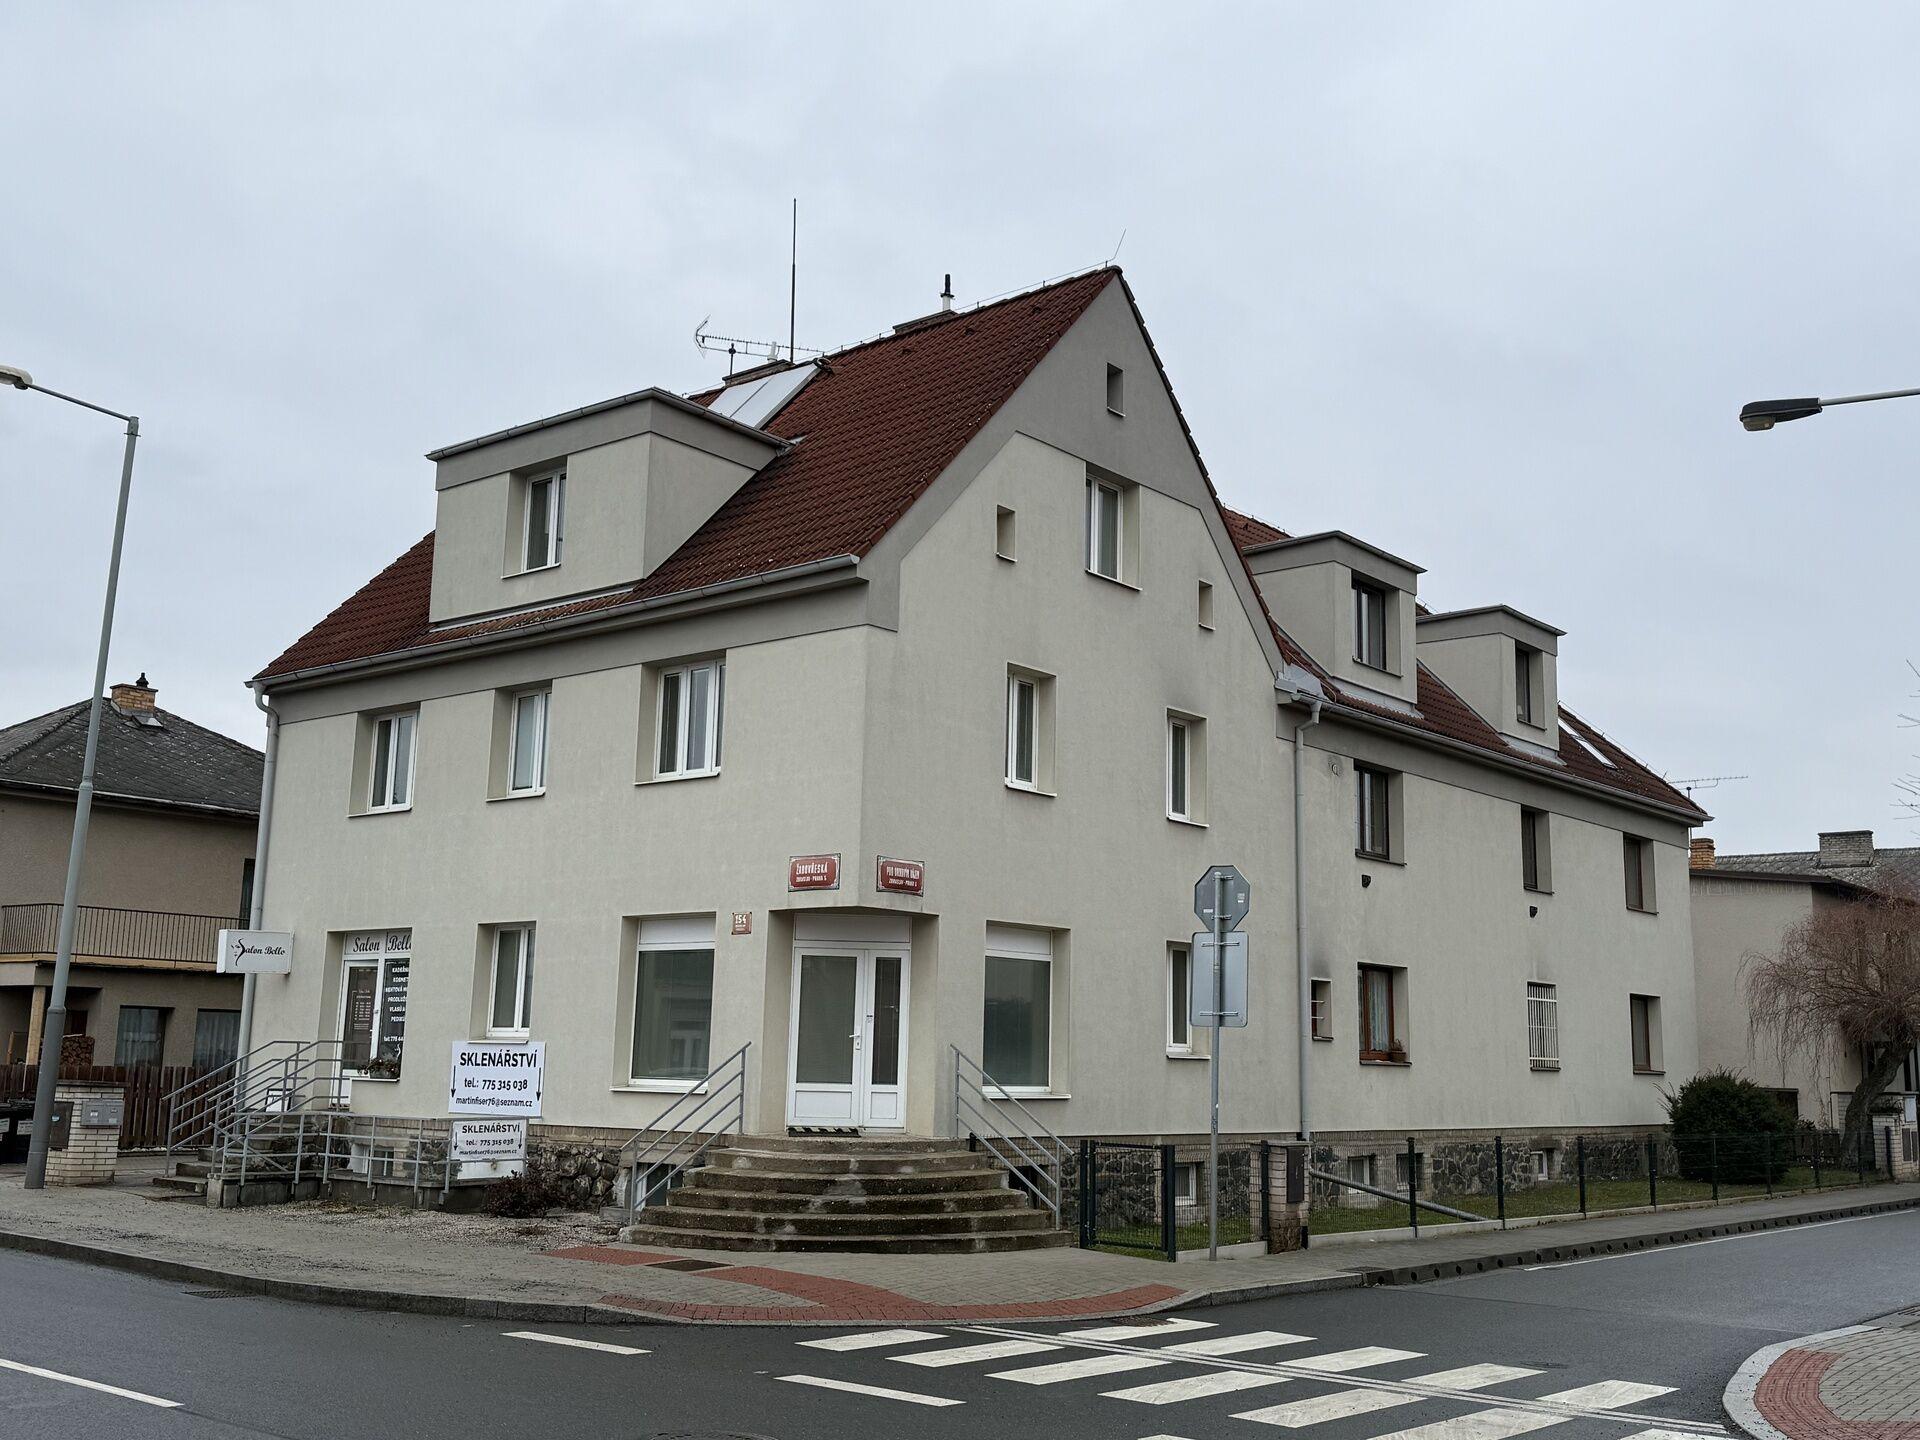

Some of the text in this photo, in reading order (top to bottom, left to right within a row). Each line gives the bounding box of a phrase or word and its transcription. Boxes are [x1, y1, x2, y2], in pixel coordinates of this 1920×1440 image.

[353, 934, 412, 952] Salon Bell
[235, 938, 262, 967] Salon
[460, 1049, 538, 1068] SKLENÁŘSTVÍ
[464, 1078, 528, 1091] tel.: 775 315 038
[455, 1096, 533, 1108] martinfiser76@seznam.cz
[462, 1122, 520, 1134] SKLENÁŘSTVÍ
[480, 1139, 491, 1147] 775
[492, 1139, 502, 1147] 315
[503, 1138, 514, 1146] 038
